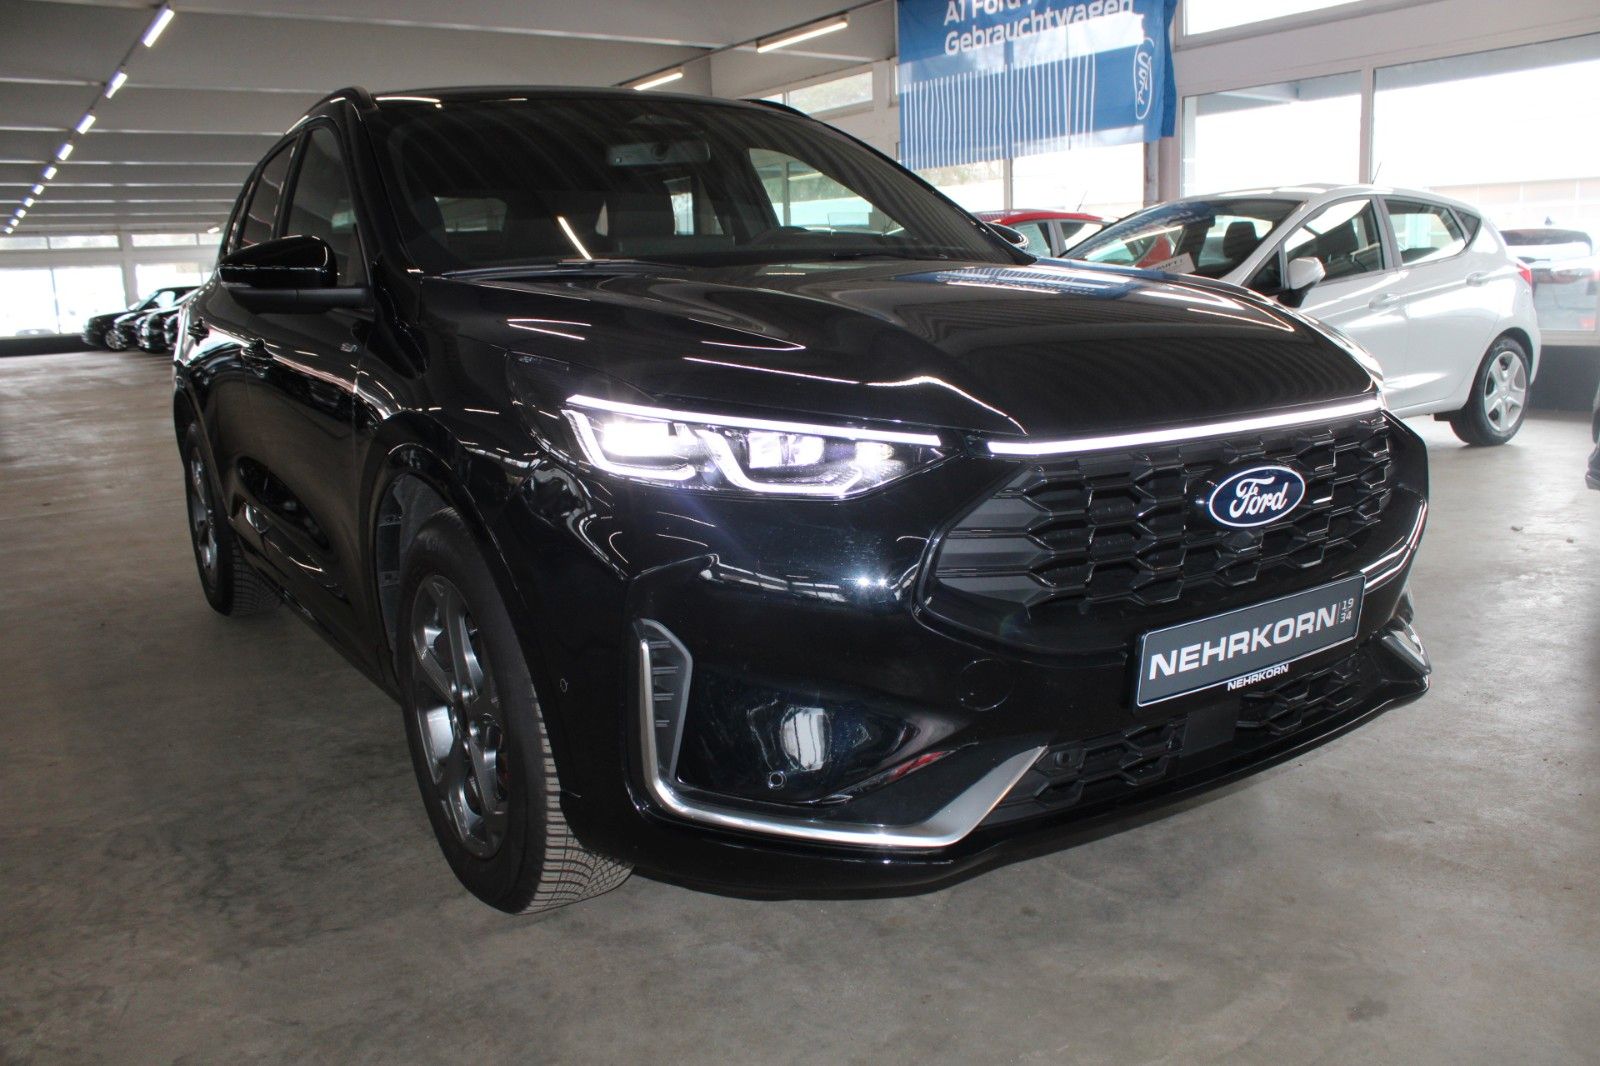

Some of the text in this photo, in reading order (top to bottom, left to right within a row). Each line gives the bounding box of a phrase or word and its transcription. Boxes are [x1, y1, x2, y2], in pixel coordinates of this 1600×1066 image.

[945, 0, 1133, 55] Gebrauchtwagen
[1229, 476, 1289, 518] Ford
[1340, 610, 1352, 623] 34
[1341, 598, 1354, 610] 19
[1149, 603, 1337, 680] NEHRKORN
[1227, 664, 1289, 691] NEHRKORN
